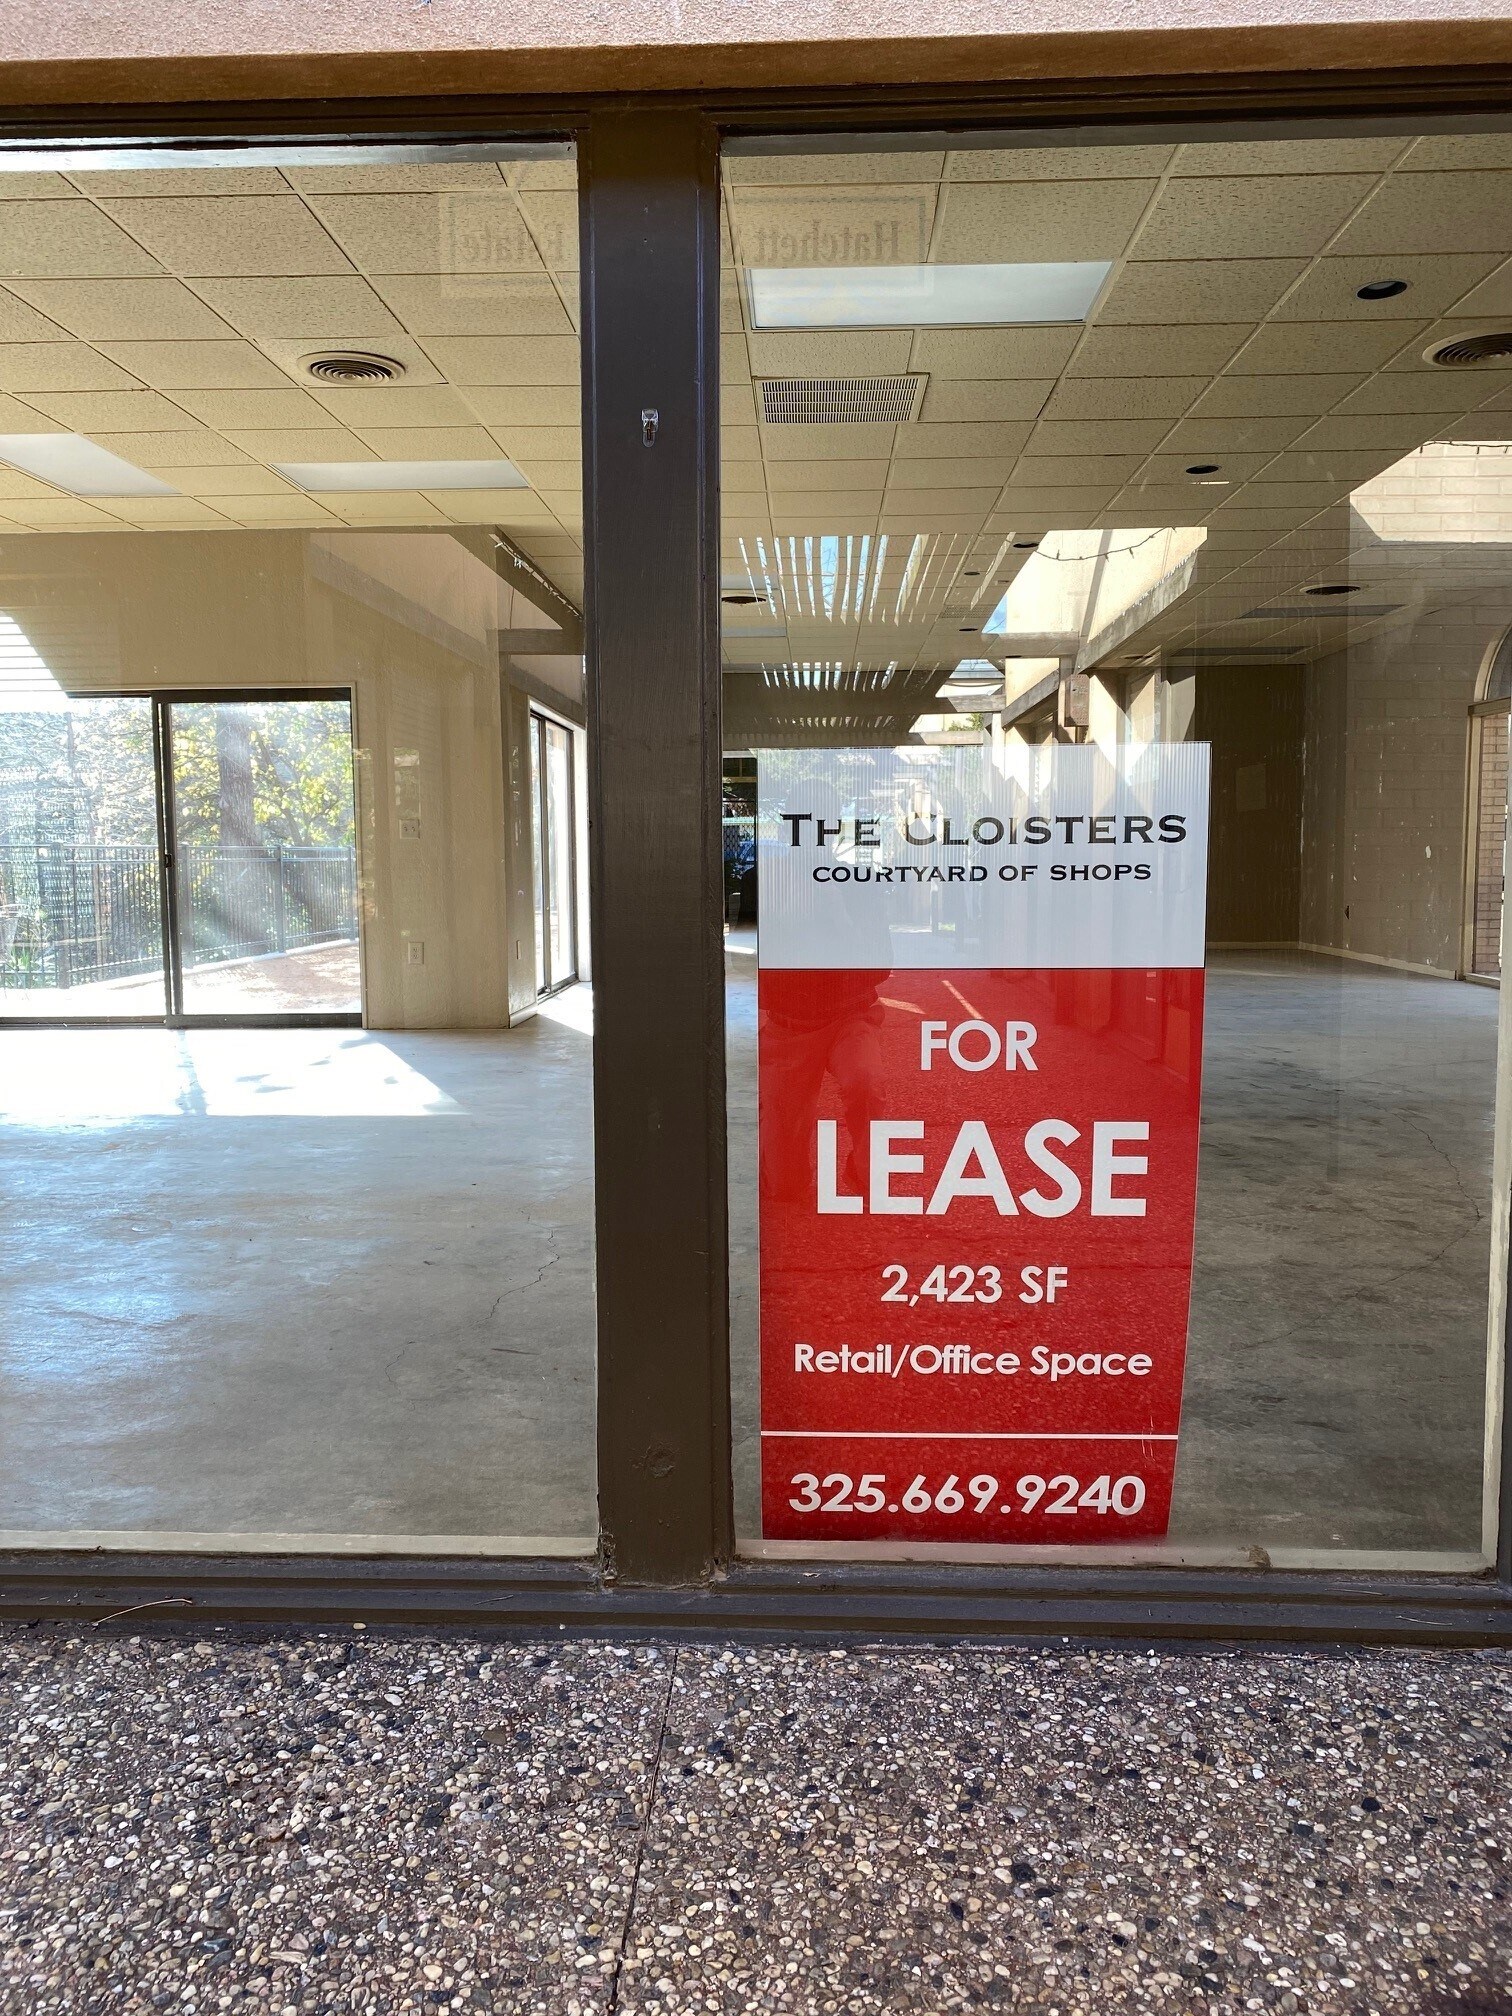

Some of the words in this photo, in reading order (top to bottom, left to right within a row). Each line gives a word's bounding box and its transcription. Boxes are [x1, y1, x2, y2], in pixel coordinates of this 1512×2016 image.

[812, 865, 988, 883] COURTYARD
[998, 864, 1038, 882] OF
[1050, 863, 1152, 881] SHOPS
[920, 1019, 1039, 1073] FOR
[816, 1119, 1150, 1218] LEASE
[880, 1264, 1002, 1307] 2,423
[1018, 1265, 1068, 1304] SF
[794, 1343, 1020, 1379] Retail/Office
[1030, 1345, 1153, 1382] Space
[788, 1473, 1147, 1516] 325.669.9240
